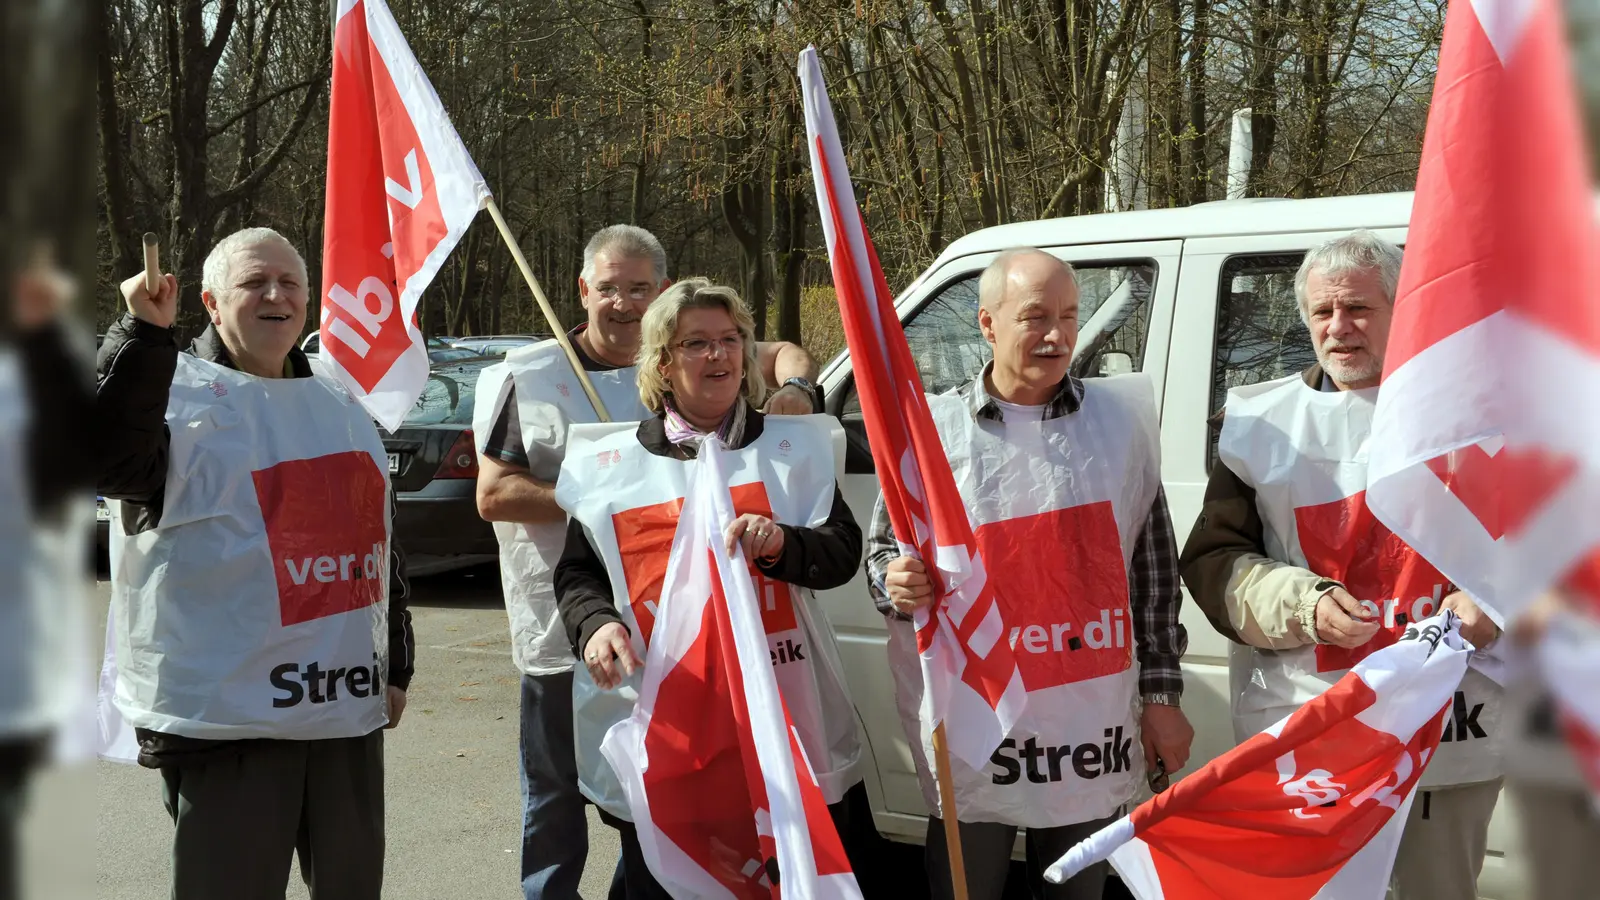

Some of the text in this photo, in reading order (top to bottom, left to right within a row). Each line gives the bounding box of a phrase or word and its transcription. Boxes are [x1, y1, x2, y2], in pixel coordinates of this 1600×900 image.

[285, 544, 383, 585] ver.d
[269, 652, 383, 708] Strei
[990, 726, 1132, 785] Streik
